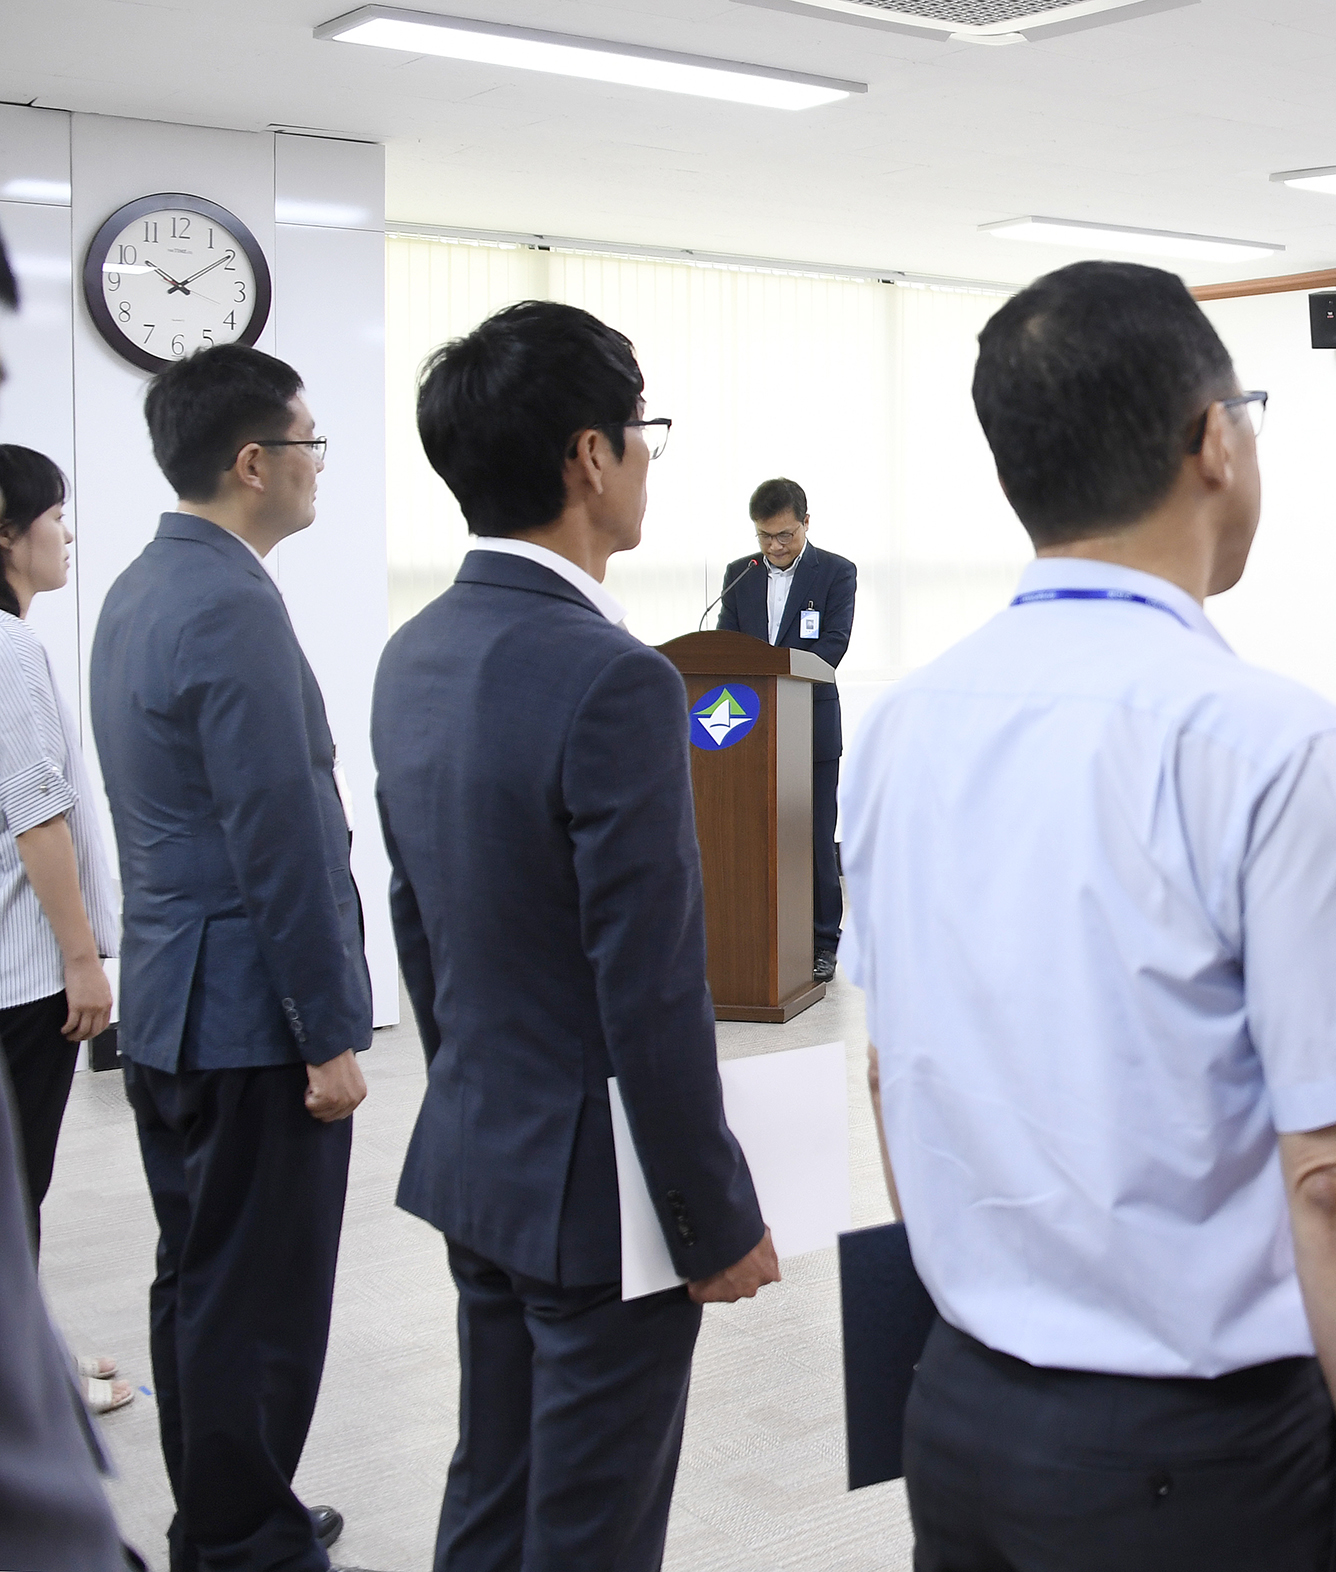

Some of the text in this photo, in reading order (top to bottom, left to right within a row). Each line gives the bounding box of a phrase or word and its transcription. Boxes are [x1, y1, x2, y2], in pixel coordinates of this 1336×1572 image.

[143, 221, 159, 243] 11
[170, 217, 191, 240] 12
[207, 228, 215, 249] 1
[118, 244, 137, 265] 10
[224, 249, 236, 271] 2
[108, 272, 120, 291] 9
[233, 281, 246, 303] 3
[118, 301, 131, 322] 8
[222, 309, 236, 330] 4
[143, 324, 155, 344] 7
[171, 334, 185, 356] 6
